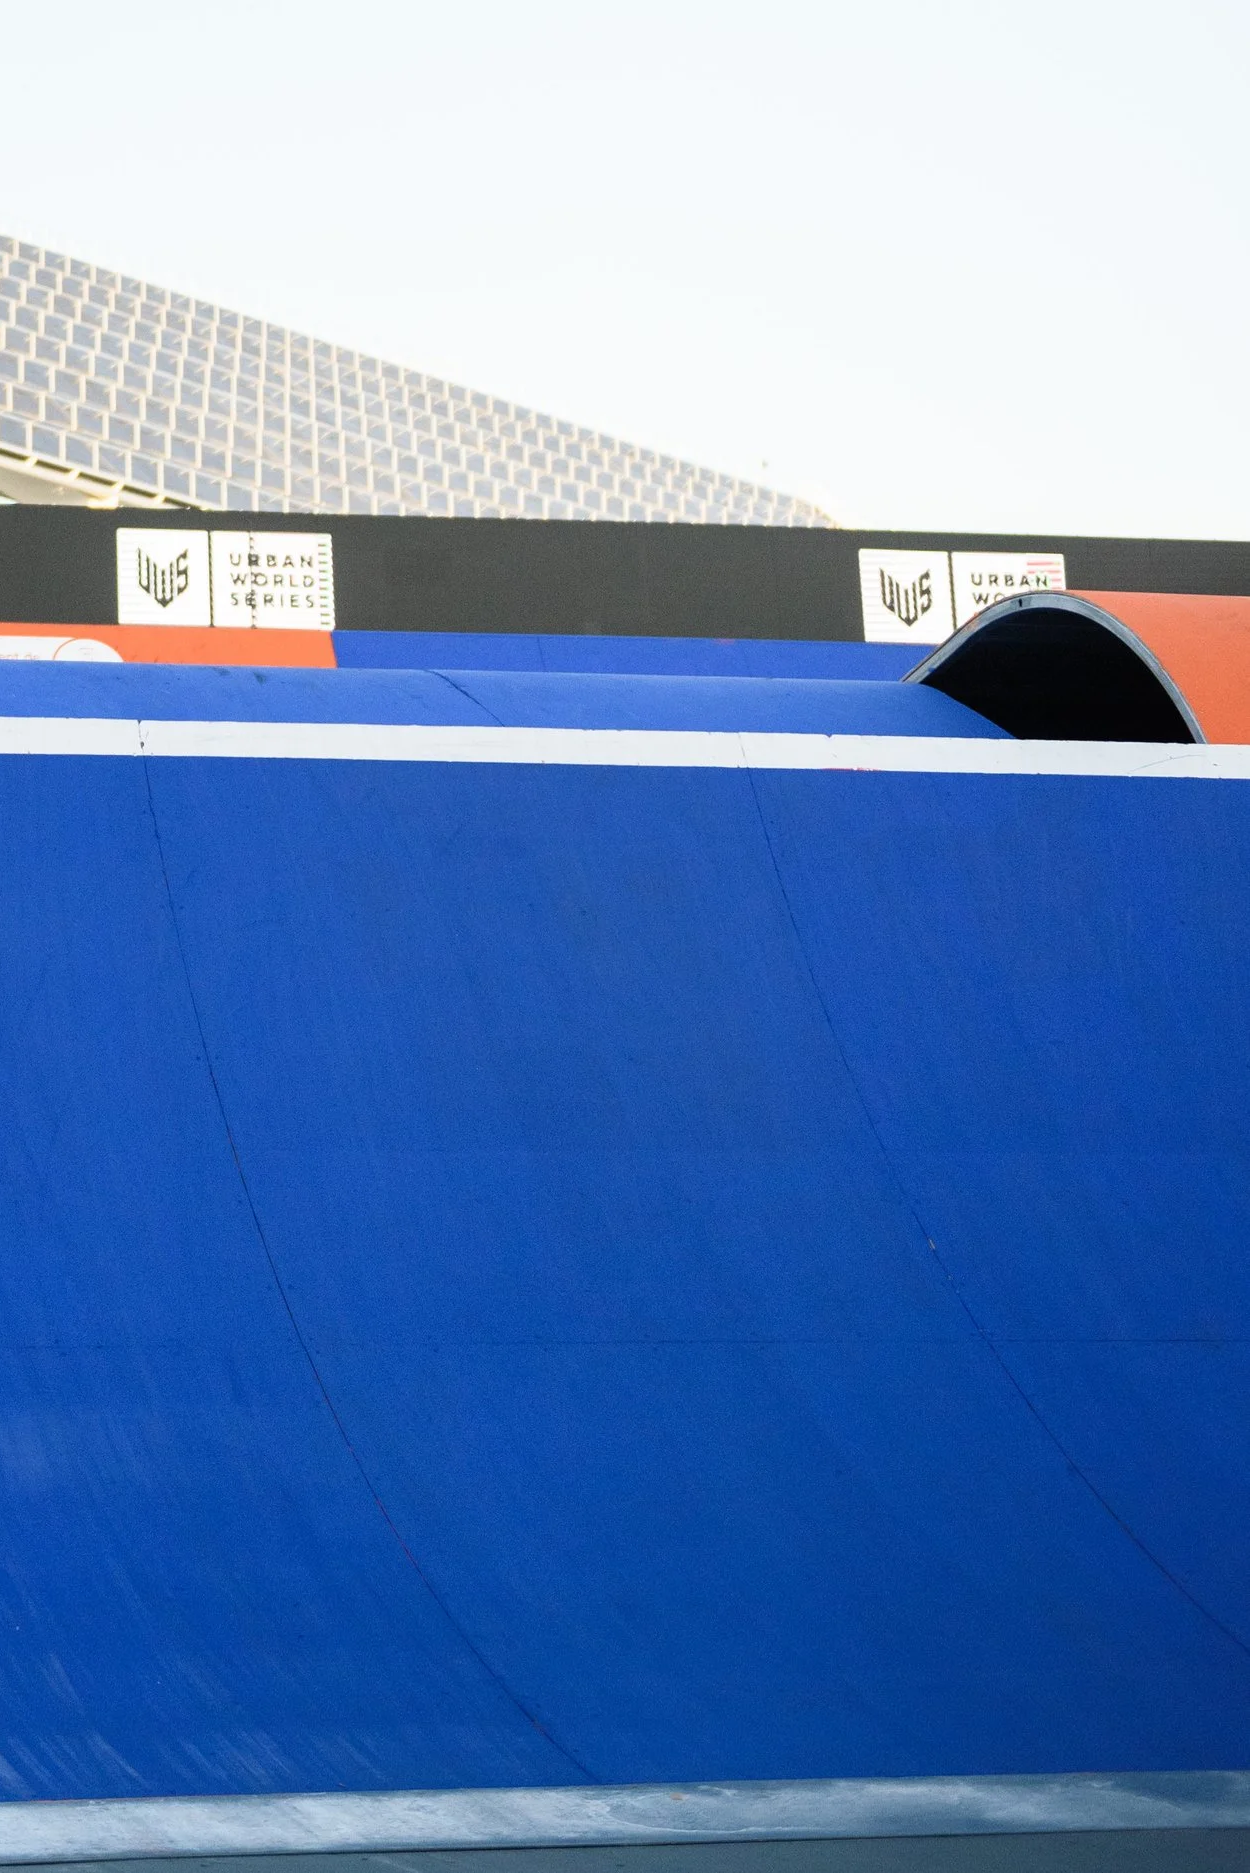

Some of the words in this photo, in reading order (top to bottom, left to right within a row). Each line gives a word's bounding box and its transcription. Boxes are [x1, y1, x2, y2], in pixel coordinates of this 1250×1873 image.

[229, 552, 314, 568] URBAN
[230, 572, 315, 588] WORLD
[970, 573, 1049, 587] URBAN
[230, 593, 315, 608] SERIES
